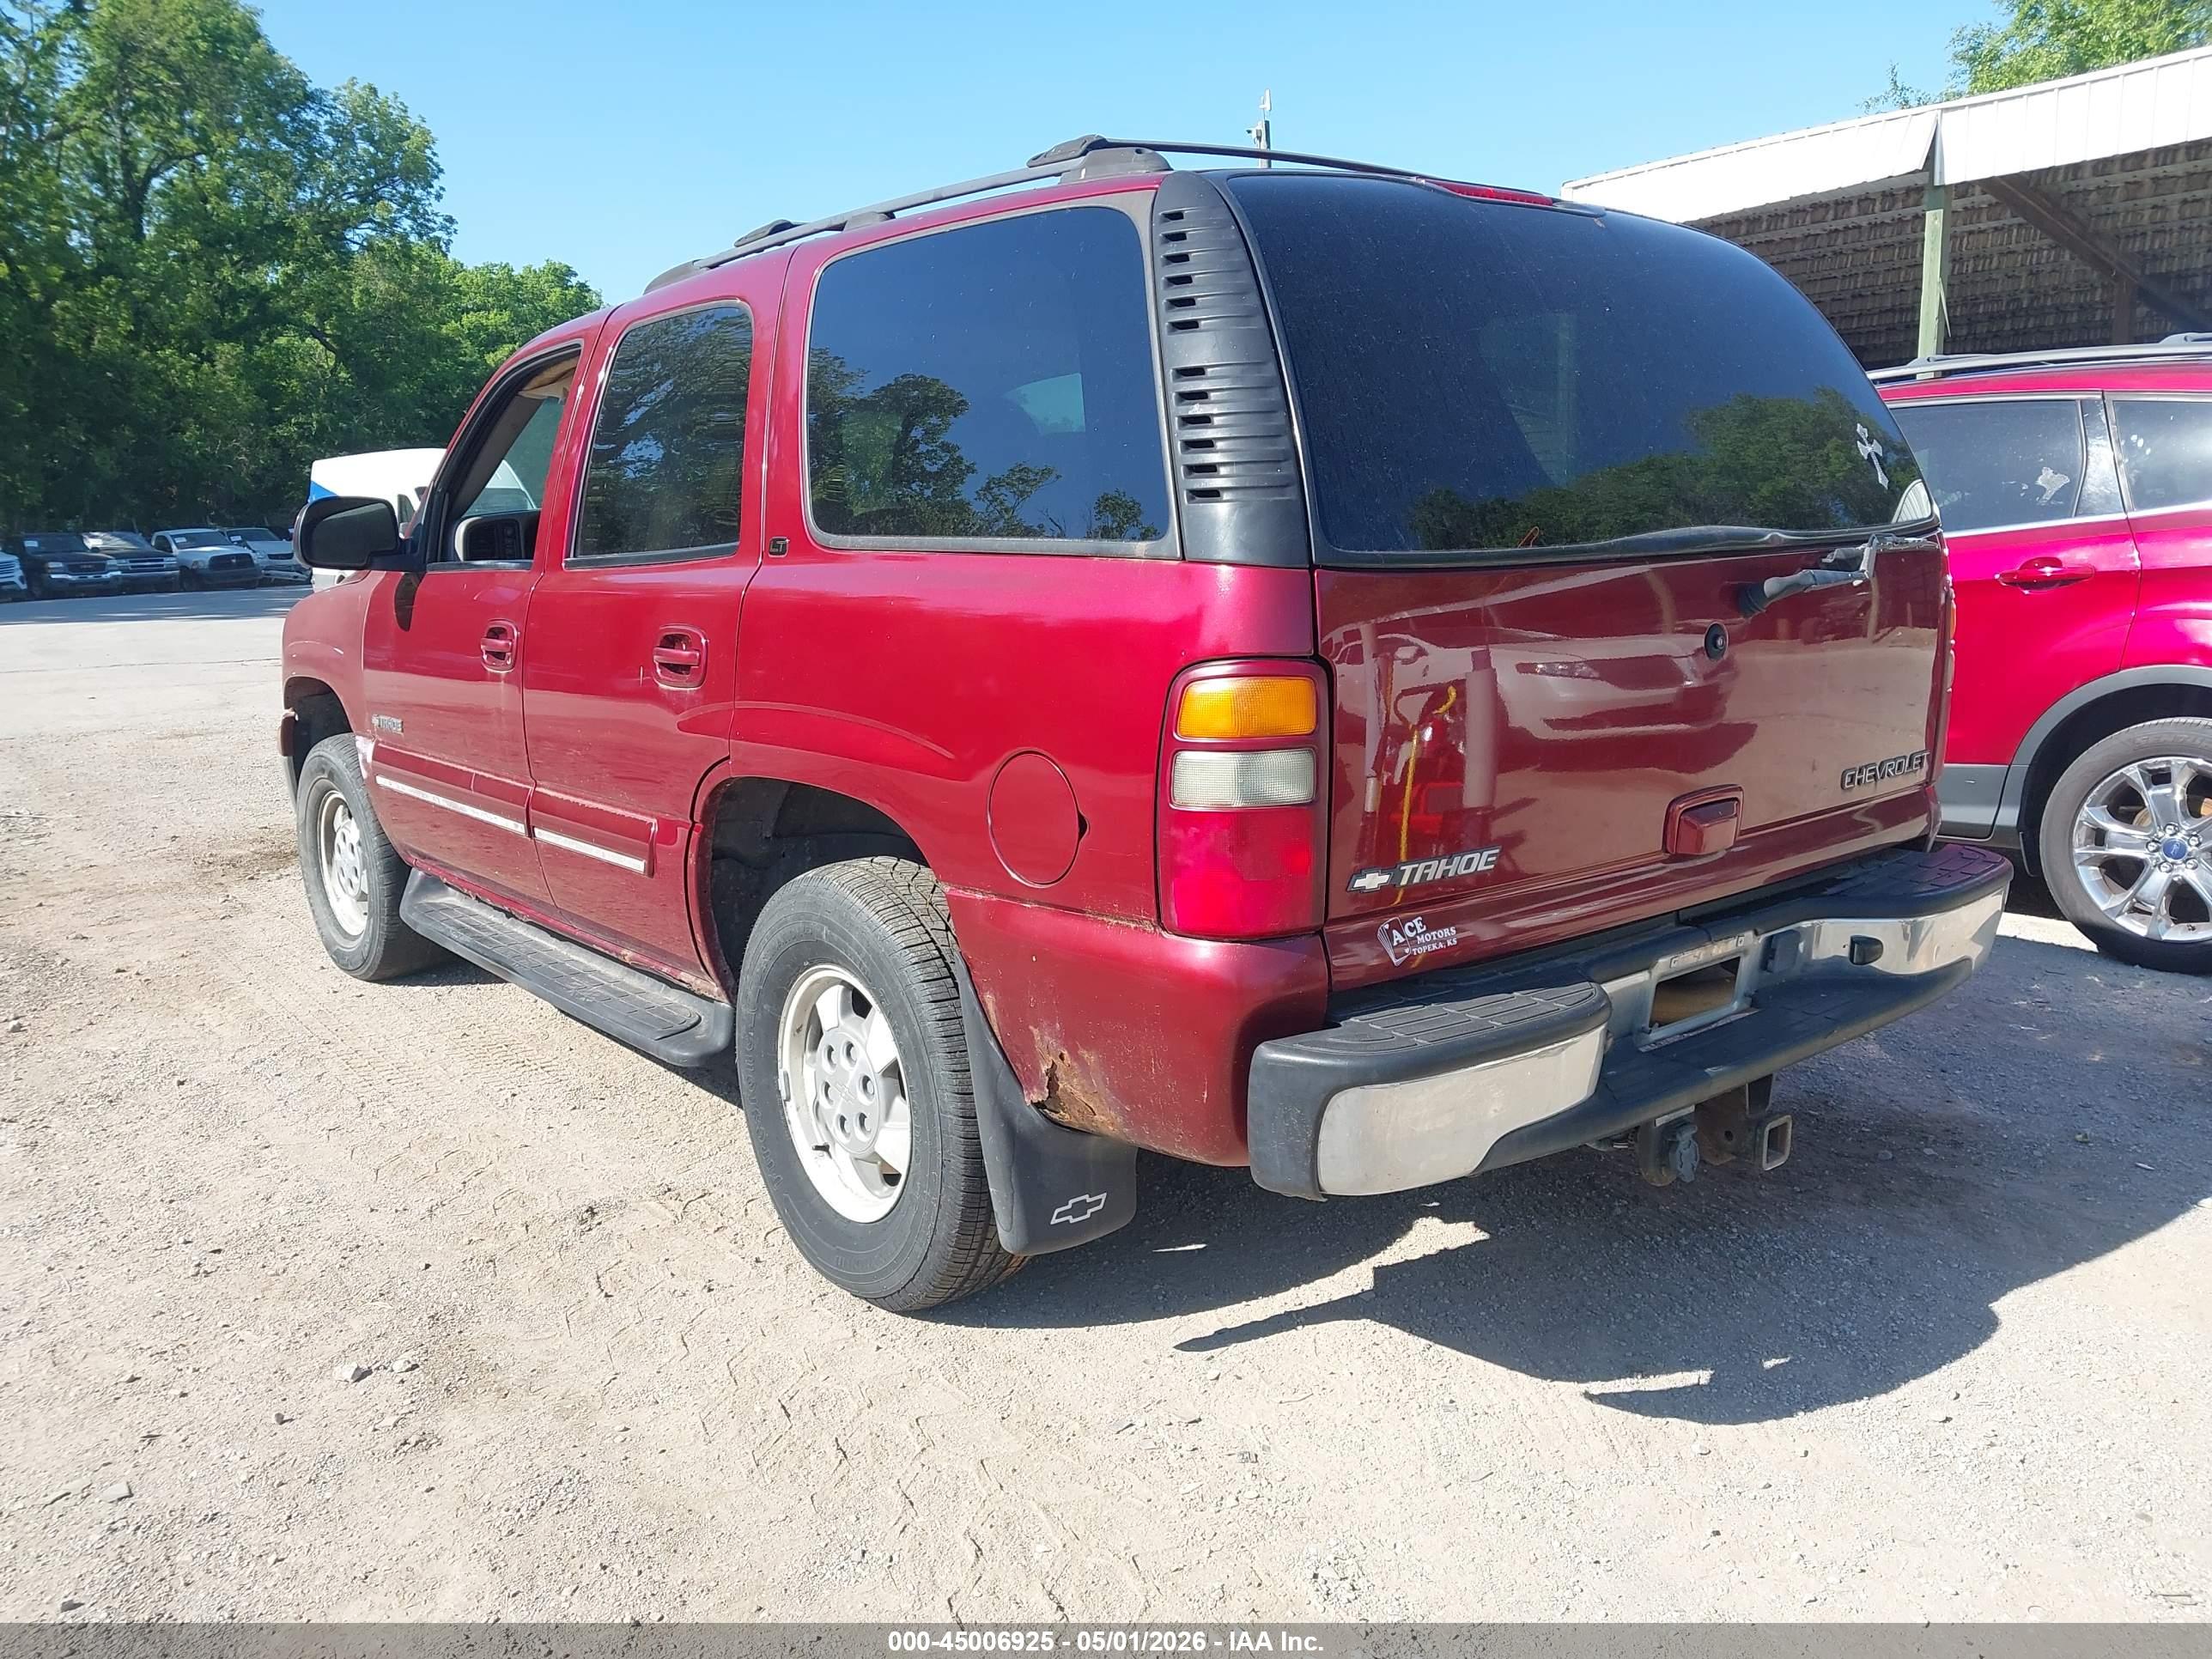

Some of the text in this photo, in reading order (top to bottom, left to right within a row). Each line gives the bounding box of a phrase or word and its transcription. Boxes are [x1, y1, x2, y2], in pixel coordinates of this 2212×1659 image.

[769, 541, 787, 552] LT
[1842, 750, 1930, 789] CHEVROLET
[1400, 848, 1500, 886] TAHOE
[1391, 916, 1426, 946] ACE
[1416, 927, 1457, 945] MOTORS
[1412, 937, 1457, 956] TOPEKA, KS
